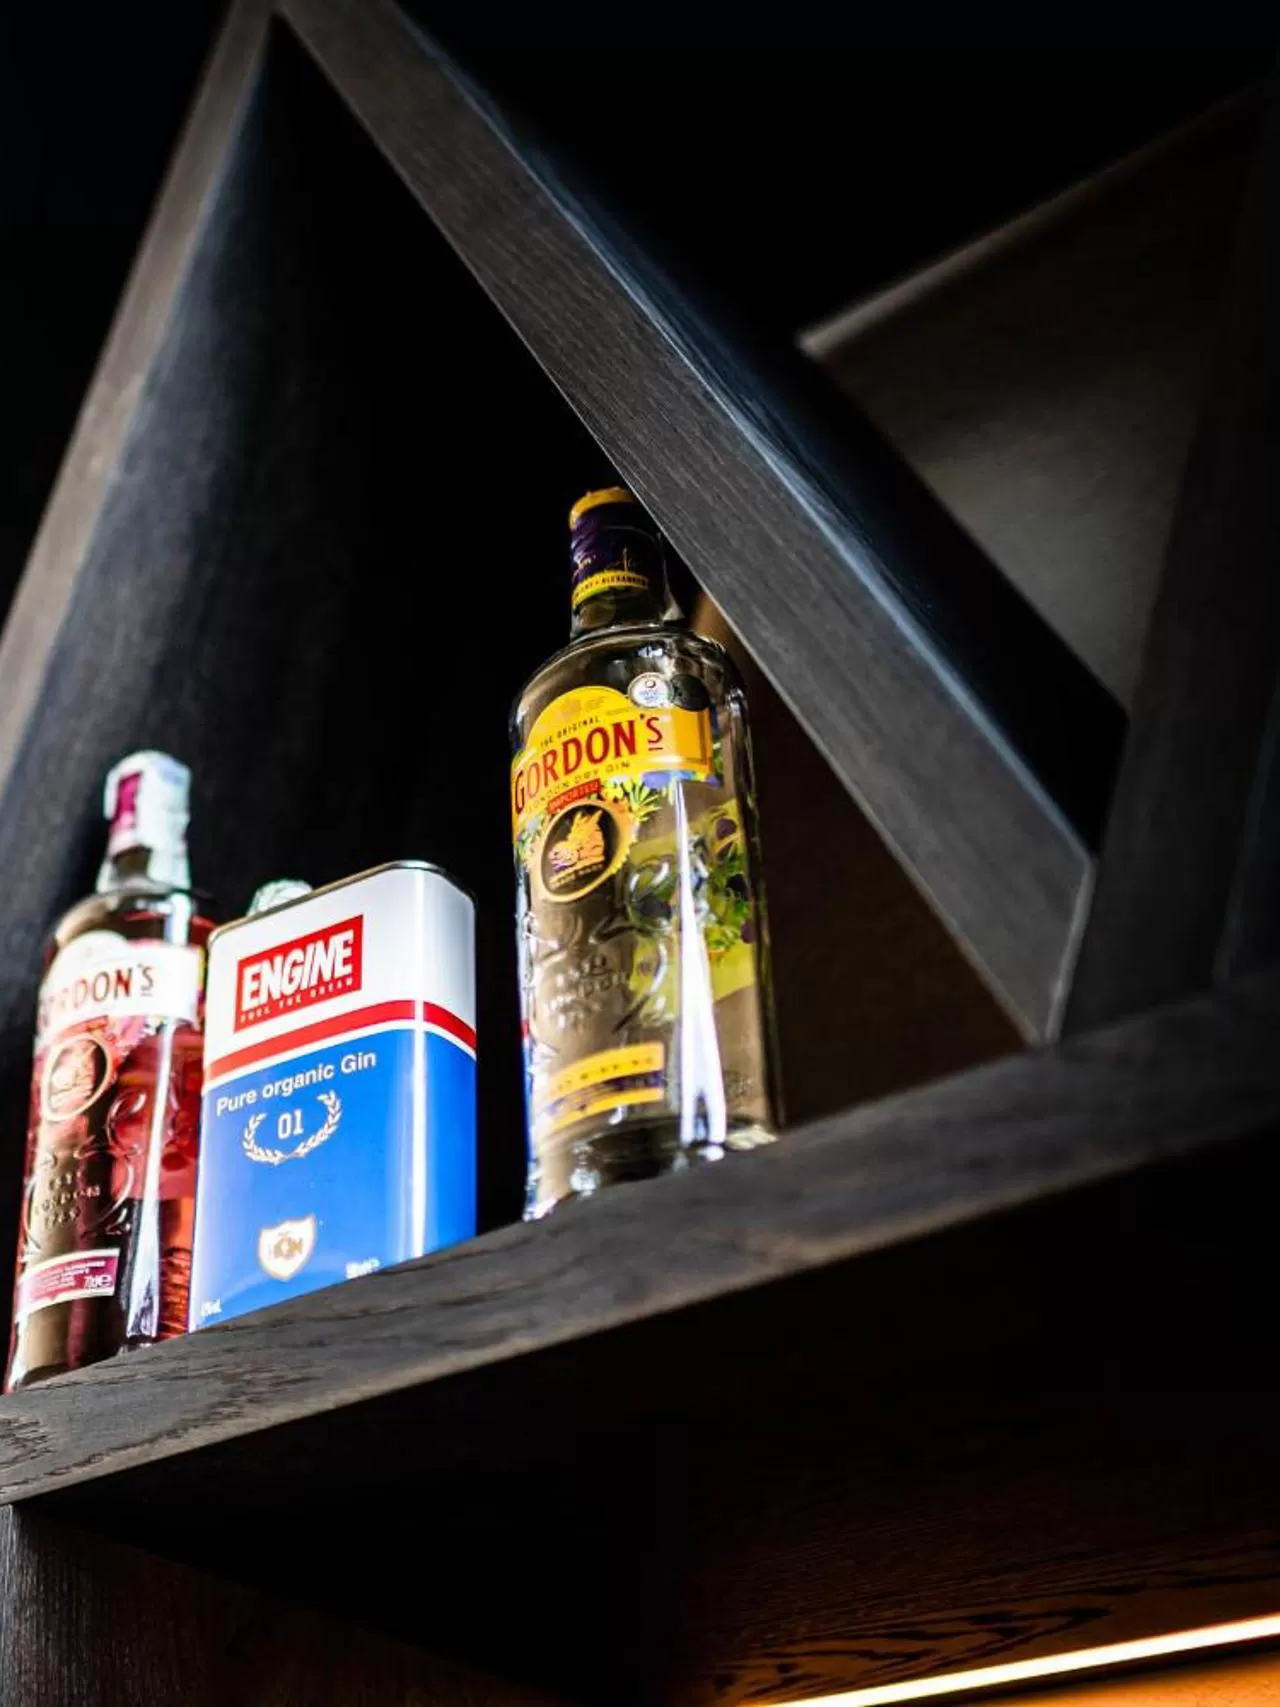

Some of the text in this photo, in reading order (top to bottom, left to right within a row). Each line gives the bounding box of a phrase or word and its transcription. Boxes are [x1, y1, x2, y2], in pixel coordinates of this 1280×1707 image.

[556, 716, 599, 739] ORIGINAL
[514, 712, 663, 815] GORDON'S
[241, 928, 354, 1012] ENGINE
[216, 1051, 377, 1117] Pure organic Gin
[277, 1109, 304, 1140] 01
